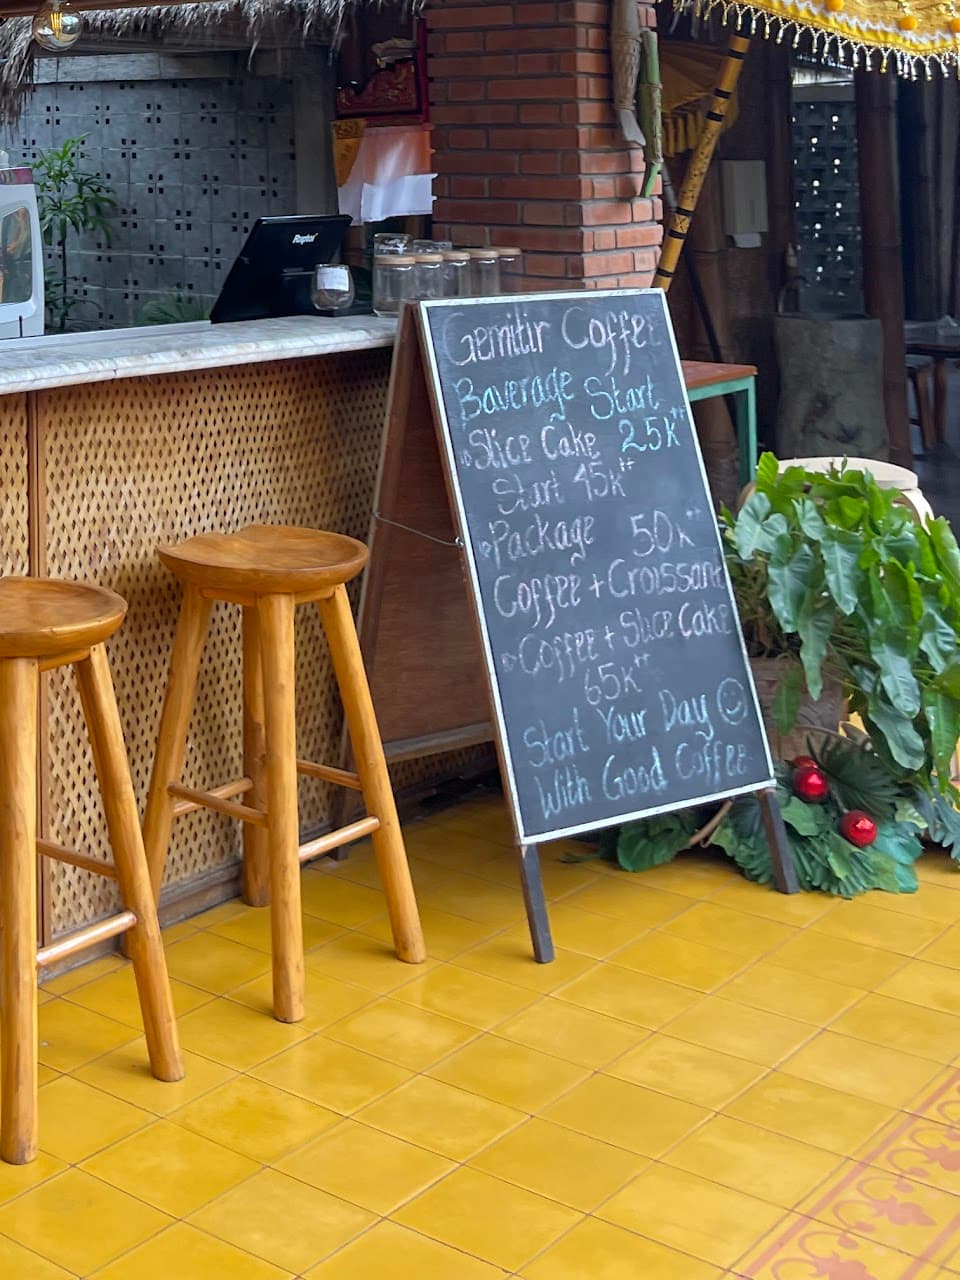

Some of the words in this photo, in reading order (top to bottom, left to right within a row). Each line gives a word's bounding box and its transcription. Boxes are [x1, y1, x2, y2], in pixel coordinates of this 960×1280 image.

[561, 306, 662, 376] Coffee
[453, 367, 575, 422] Baverage
[584, 374, 660, 420] Start
[469, 428, 532, 470] Slice
[540, 422, 600, 460] Cake
[492, 470, 564, 515] Start
[489, 513, 595, 570] Package
[493, 573, 581, 629] Coffee
[518, 628, 598, 683] Coffee
[619, 607, 674, 648] Slice
[678, 600, 732, 639] Cake
[523, 707, 590, 768] Start
[596, 705, 647, 744] Your
[658, 689, 714, 741] Day
[535, 764, 591, 819] With
[602, 745, 668, 801] Good
[675, 742, 748, 787] Coffee
